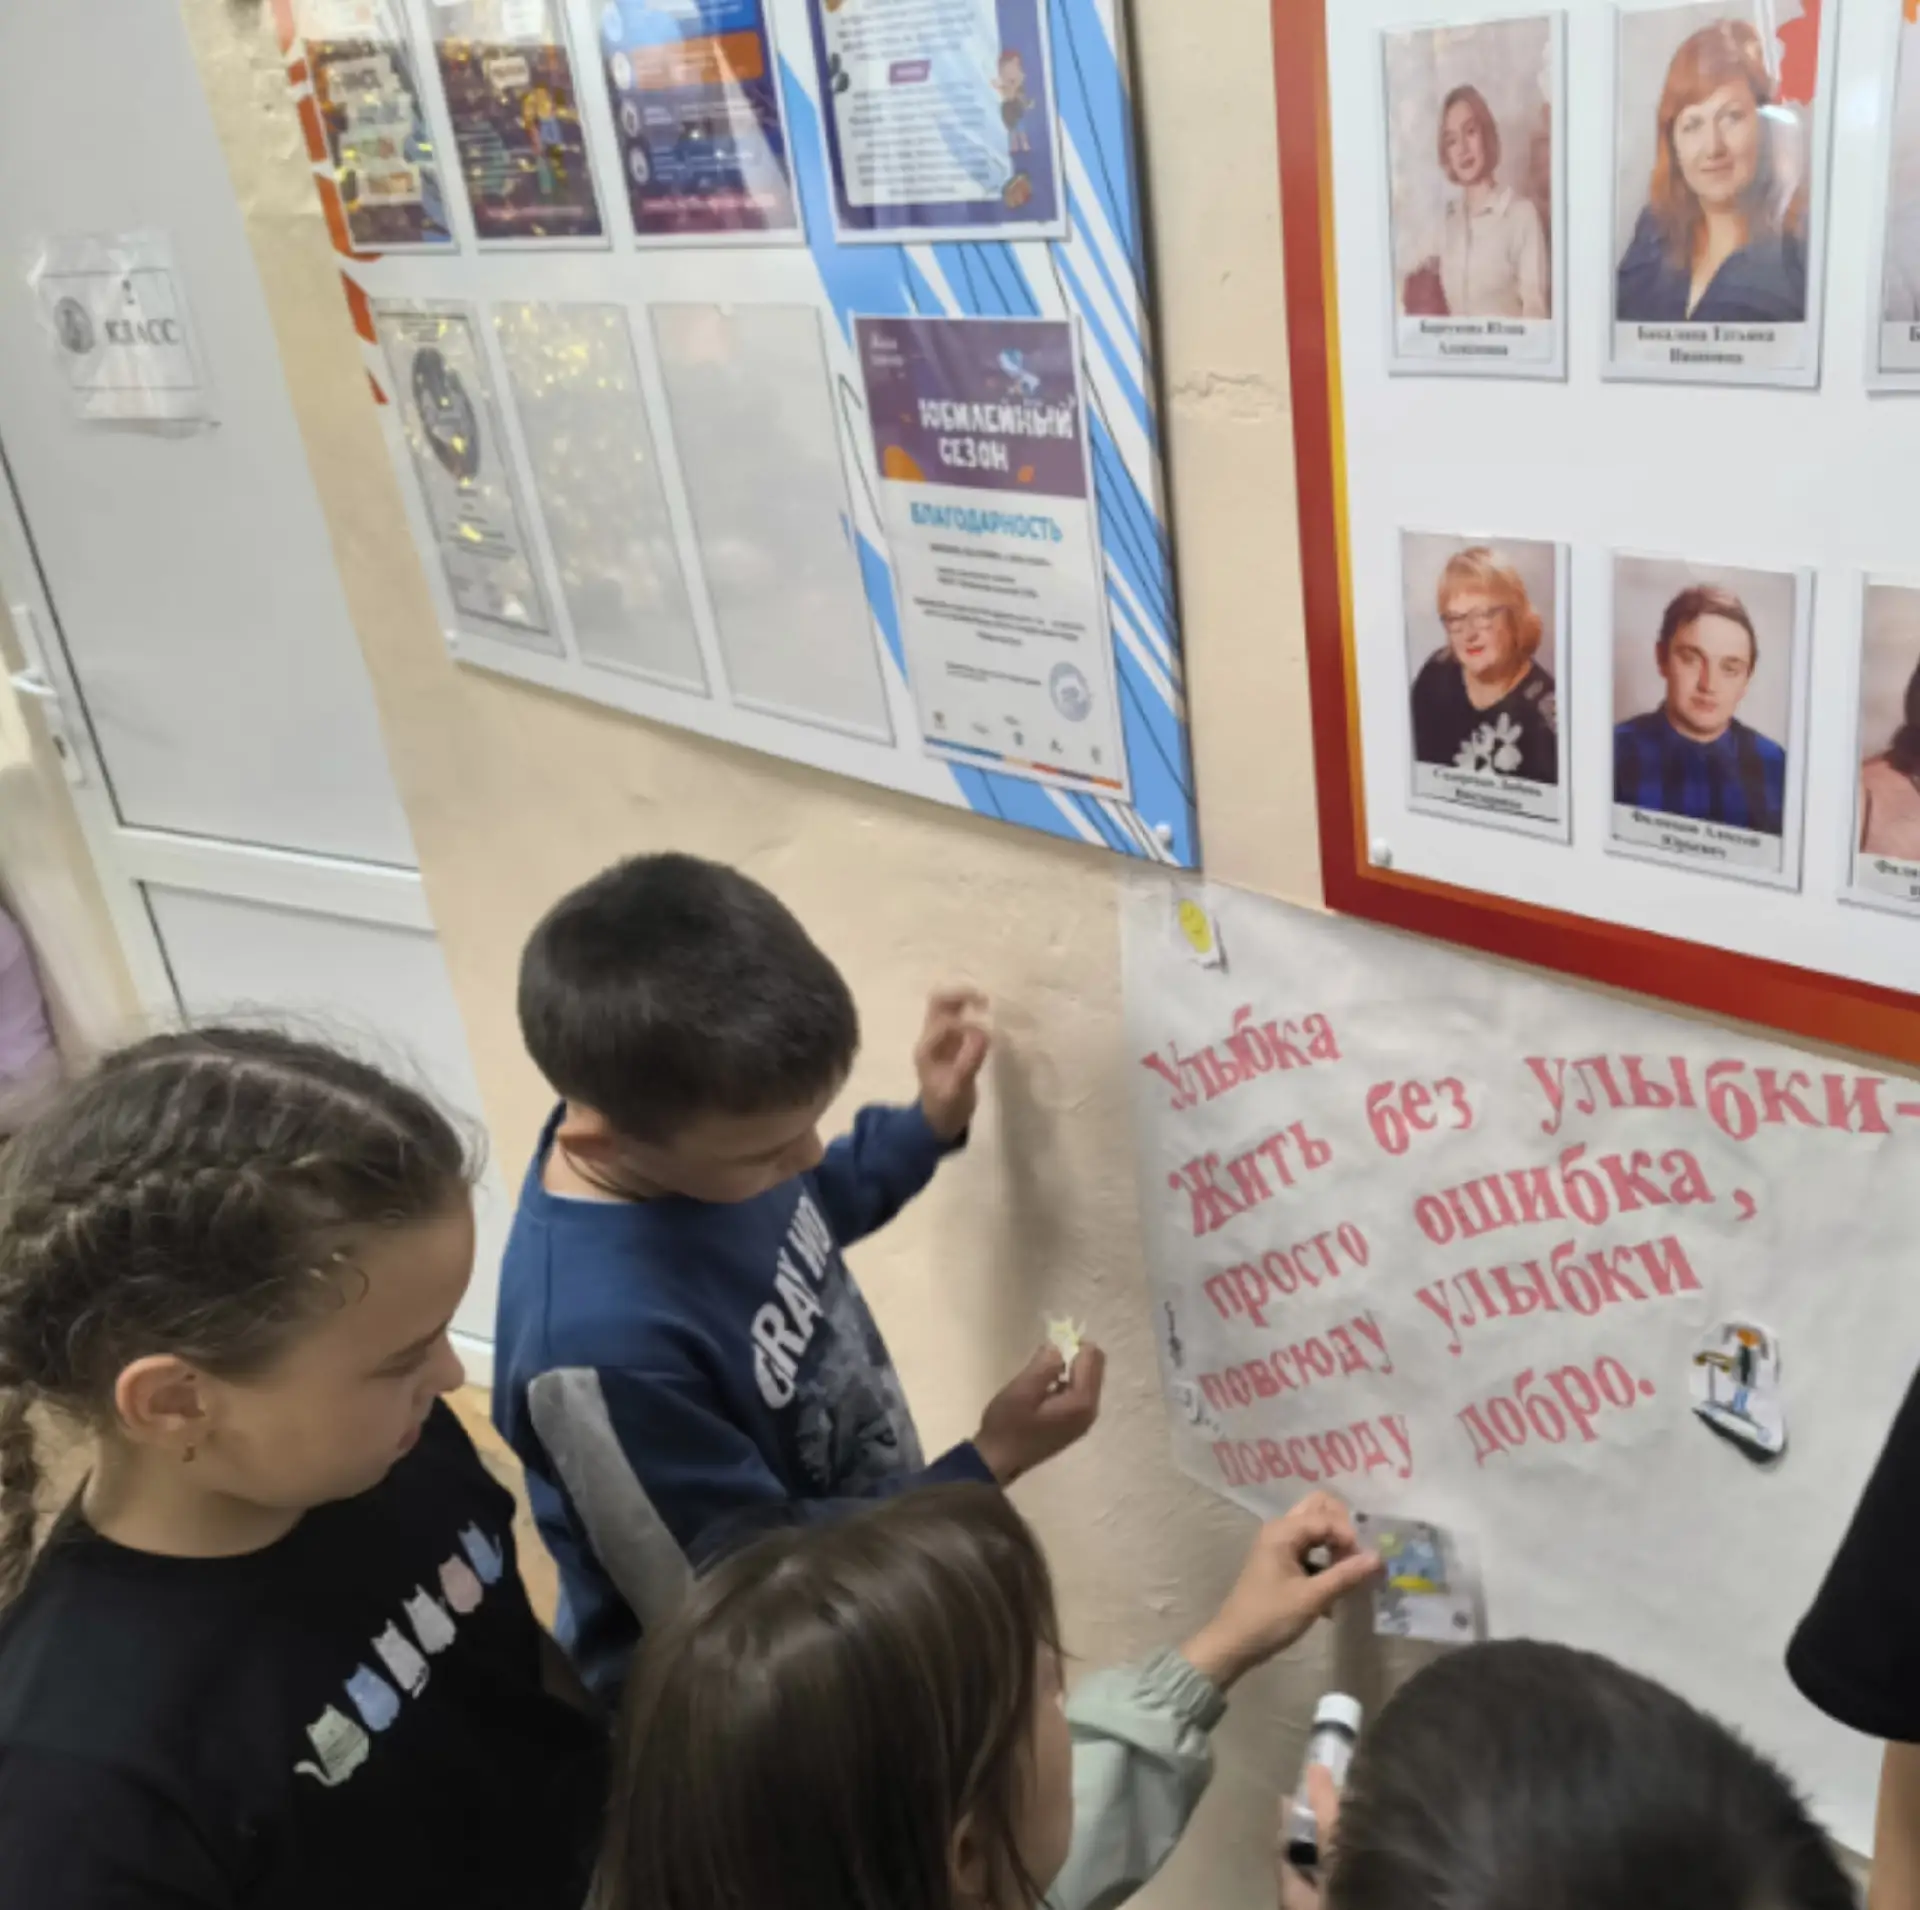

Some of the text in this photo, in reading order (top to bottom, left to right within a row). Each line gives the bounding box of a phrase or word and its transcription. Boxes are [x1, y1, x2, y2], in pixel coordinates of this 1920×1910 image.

[917, 392, 1078, 439] ЮБИЛЕЙНЫЙ
[937, 437, 1010, 472] СЕЗОН
[910, 501, 1063, 543] БЛАГОДАРНОСТЬ
[1140, 1003, 1342, 1111] Улыбка
[1168, 1120, 1333, 1238] Жить
[1365, 1076, 1473, 1155] без
[751, 1246, 824, 1409] GRAY
[1197, 1234, 1703, 1412] повсюду улыбки
[1204, 1222, 1369, 1328] просто
[1212, 1413, 1413, 1487] повсюду
